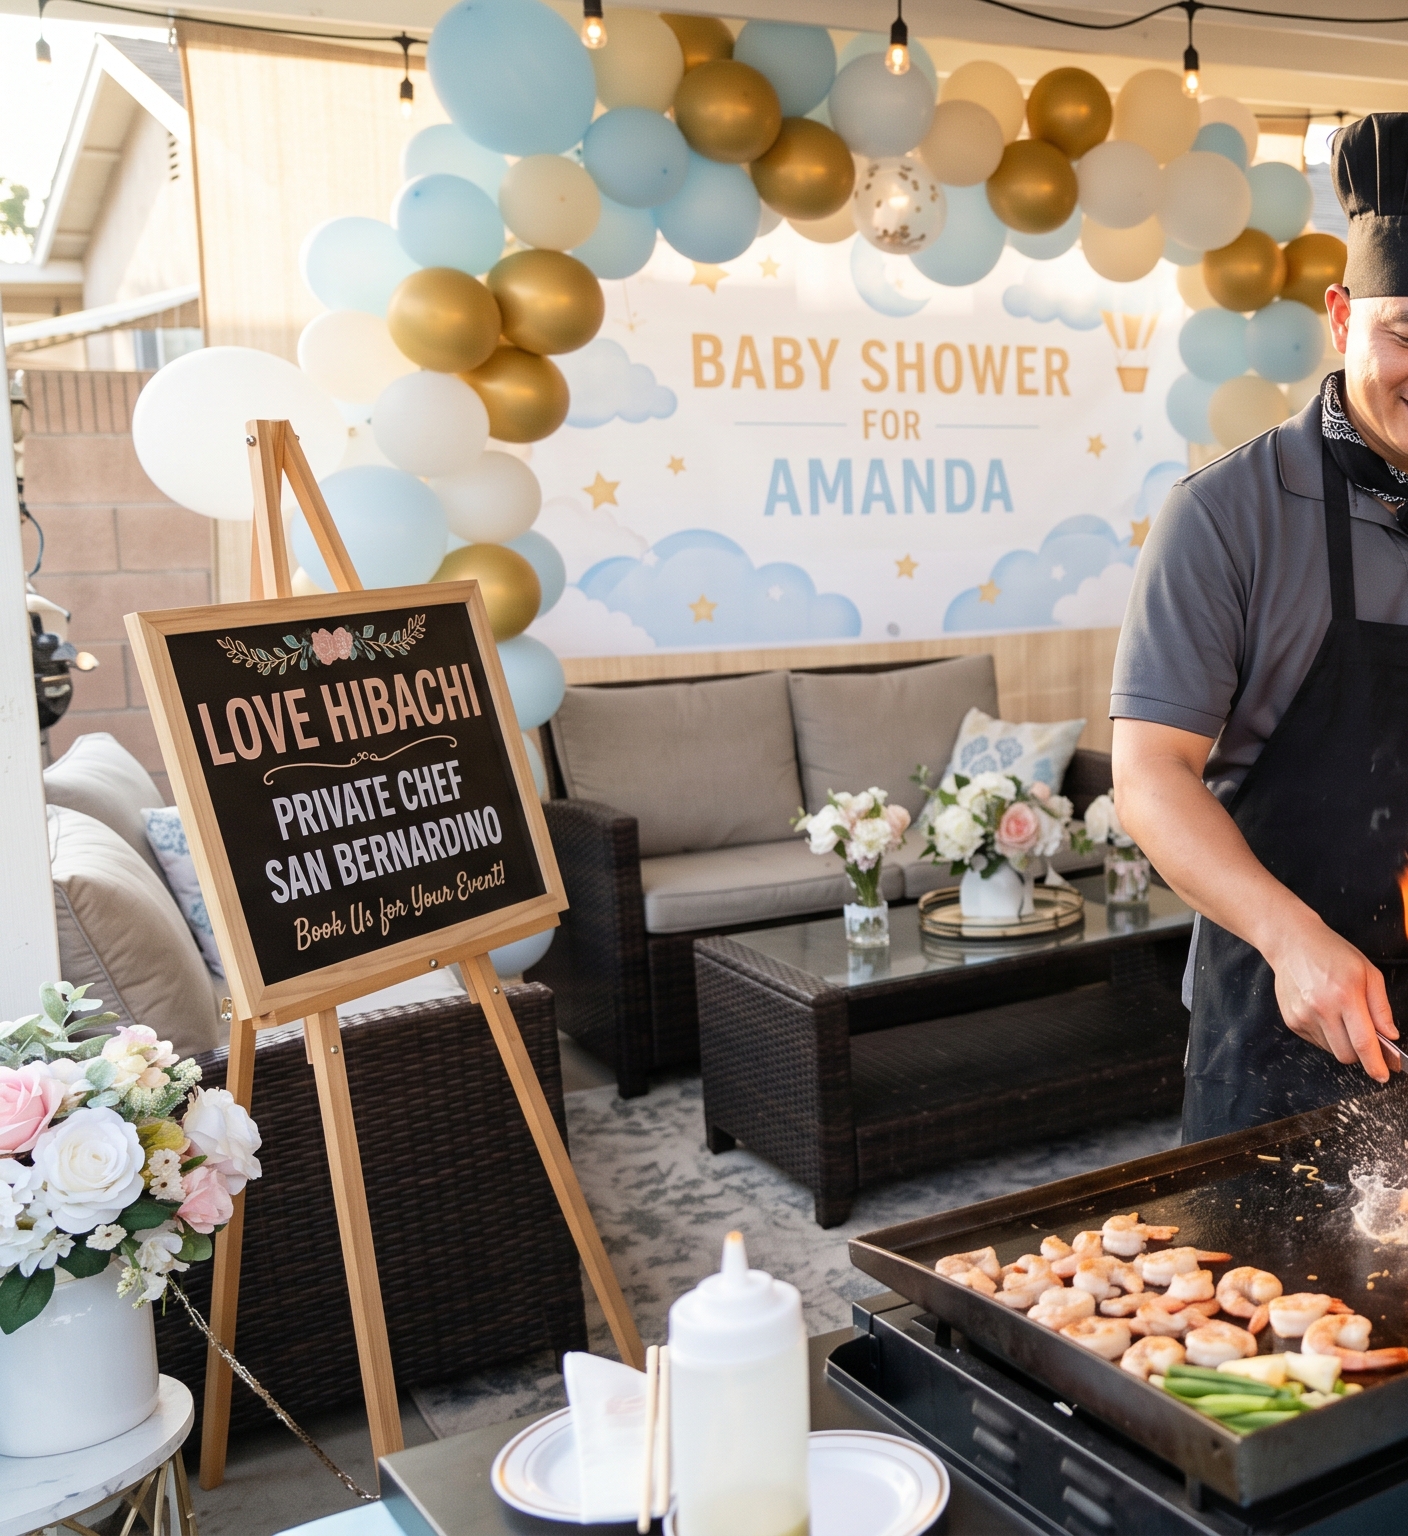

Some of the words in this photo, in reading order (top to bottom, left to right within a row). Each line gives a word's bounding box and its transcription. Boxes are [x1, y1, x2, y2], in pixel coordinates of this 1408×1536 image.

[691, 333, 841, 391] BABY
[860, 339, 1072, 397] SHOWER
[863, 409, 921, 441] FOR
[763, 458, 1015, 516] AMANDA
[197, 688, 320, 766] LOVE
[319, 663, 482, 743] HIBACHI
[272, 774, 397, 841] PRIVATE
[397, 759, 462, 811] CHEF
[265, 849, 332, 904] SAN
[333, 805, 503, 887] BERNARDINO
[294, 911, 346, 951] Book
[350, 901, 374, 935] Us
[379, 897, 408, 936] for
[410, 883, 454, 917] Your
[456, 860, 506, 901] Event!
